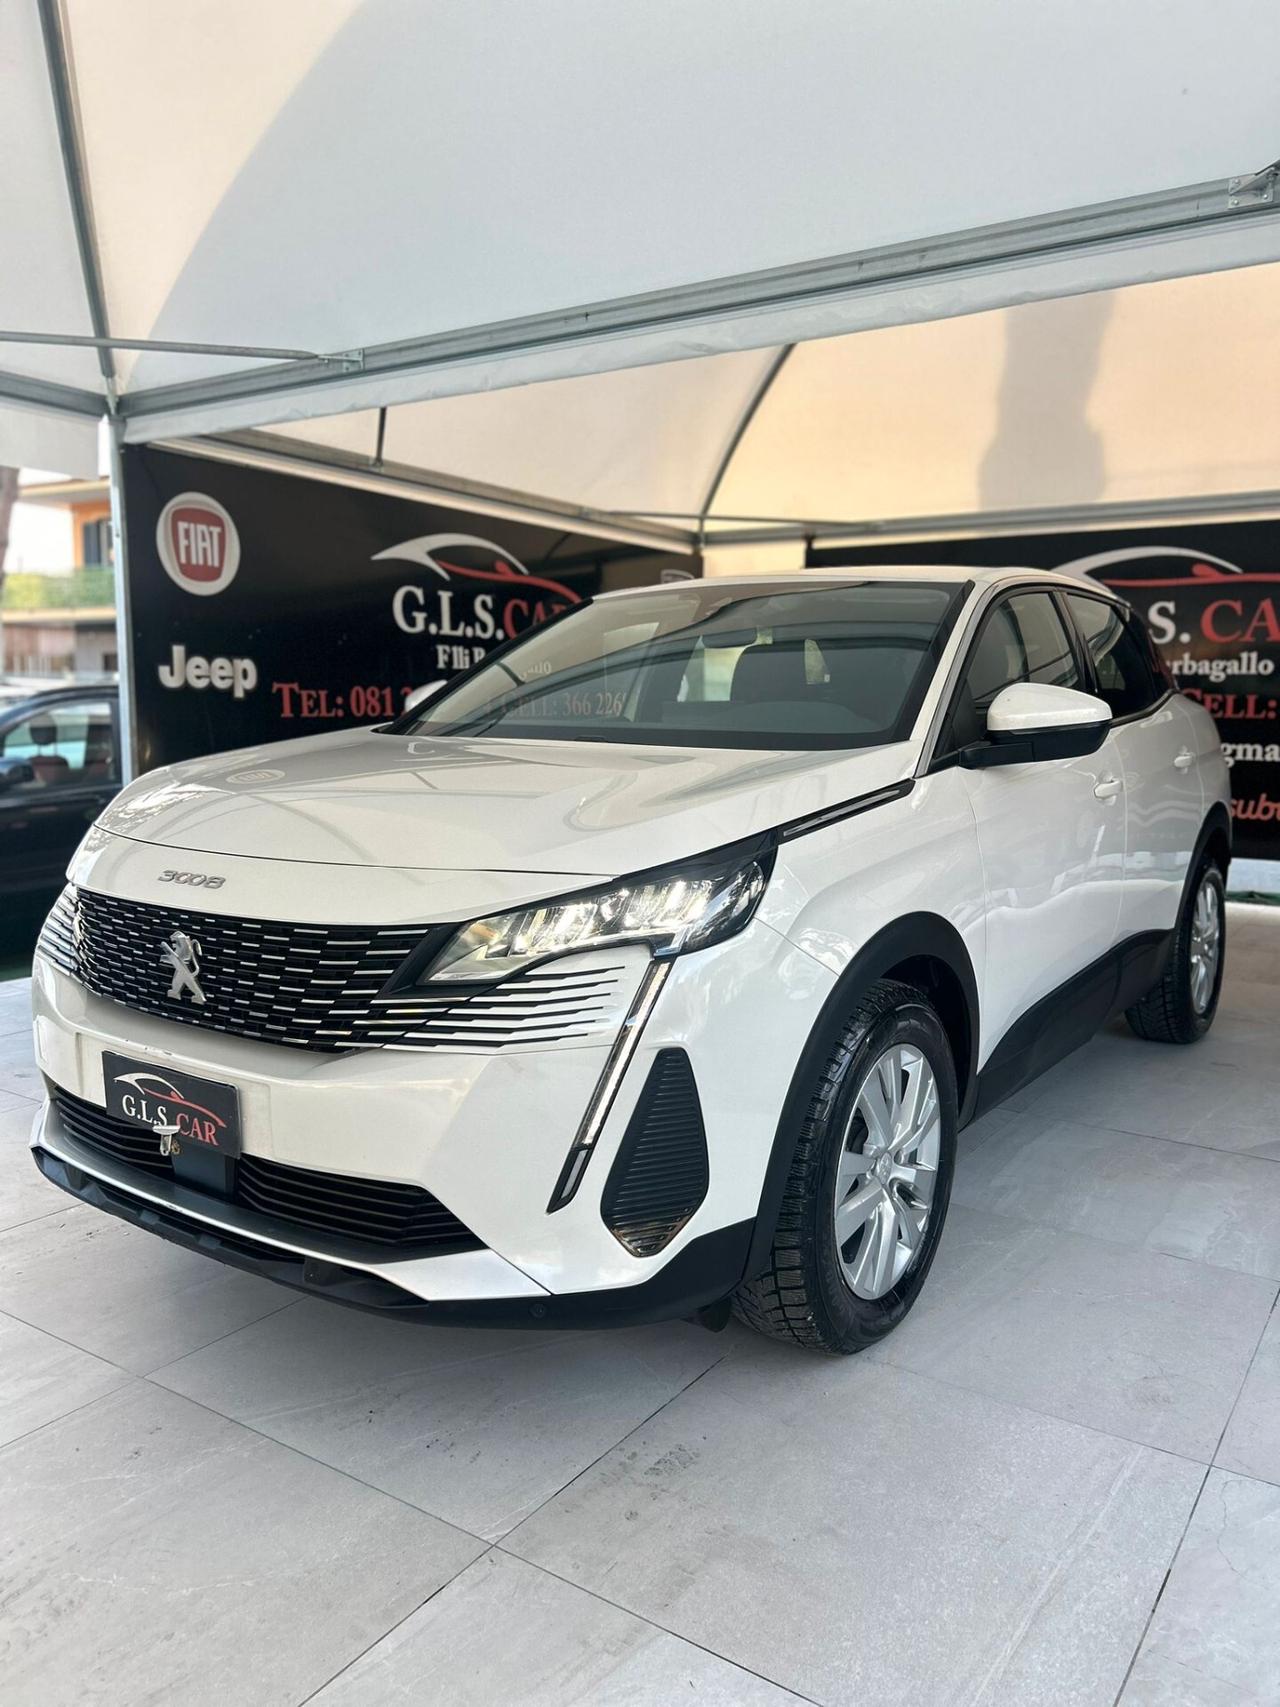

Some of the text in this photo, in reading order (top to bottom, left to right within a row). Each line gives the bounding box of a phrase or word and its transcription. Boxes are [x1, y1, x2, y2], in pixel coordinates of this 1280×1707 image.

[177, 521, 222, 568] FIAT
[503, 599, 567, 640] CA
[158, 645, 257, 698] Jeep
[1165, 651, 1275, 683] rbagallo
[350, 685, 395, 717] 081
[563, 692, 592, 717] 366
[158, 869, 226, 889] 3008
[176, 1113, 219, 1147] CAR
